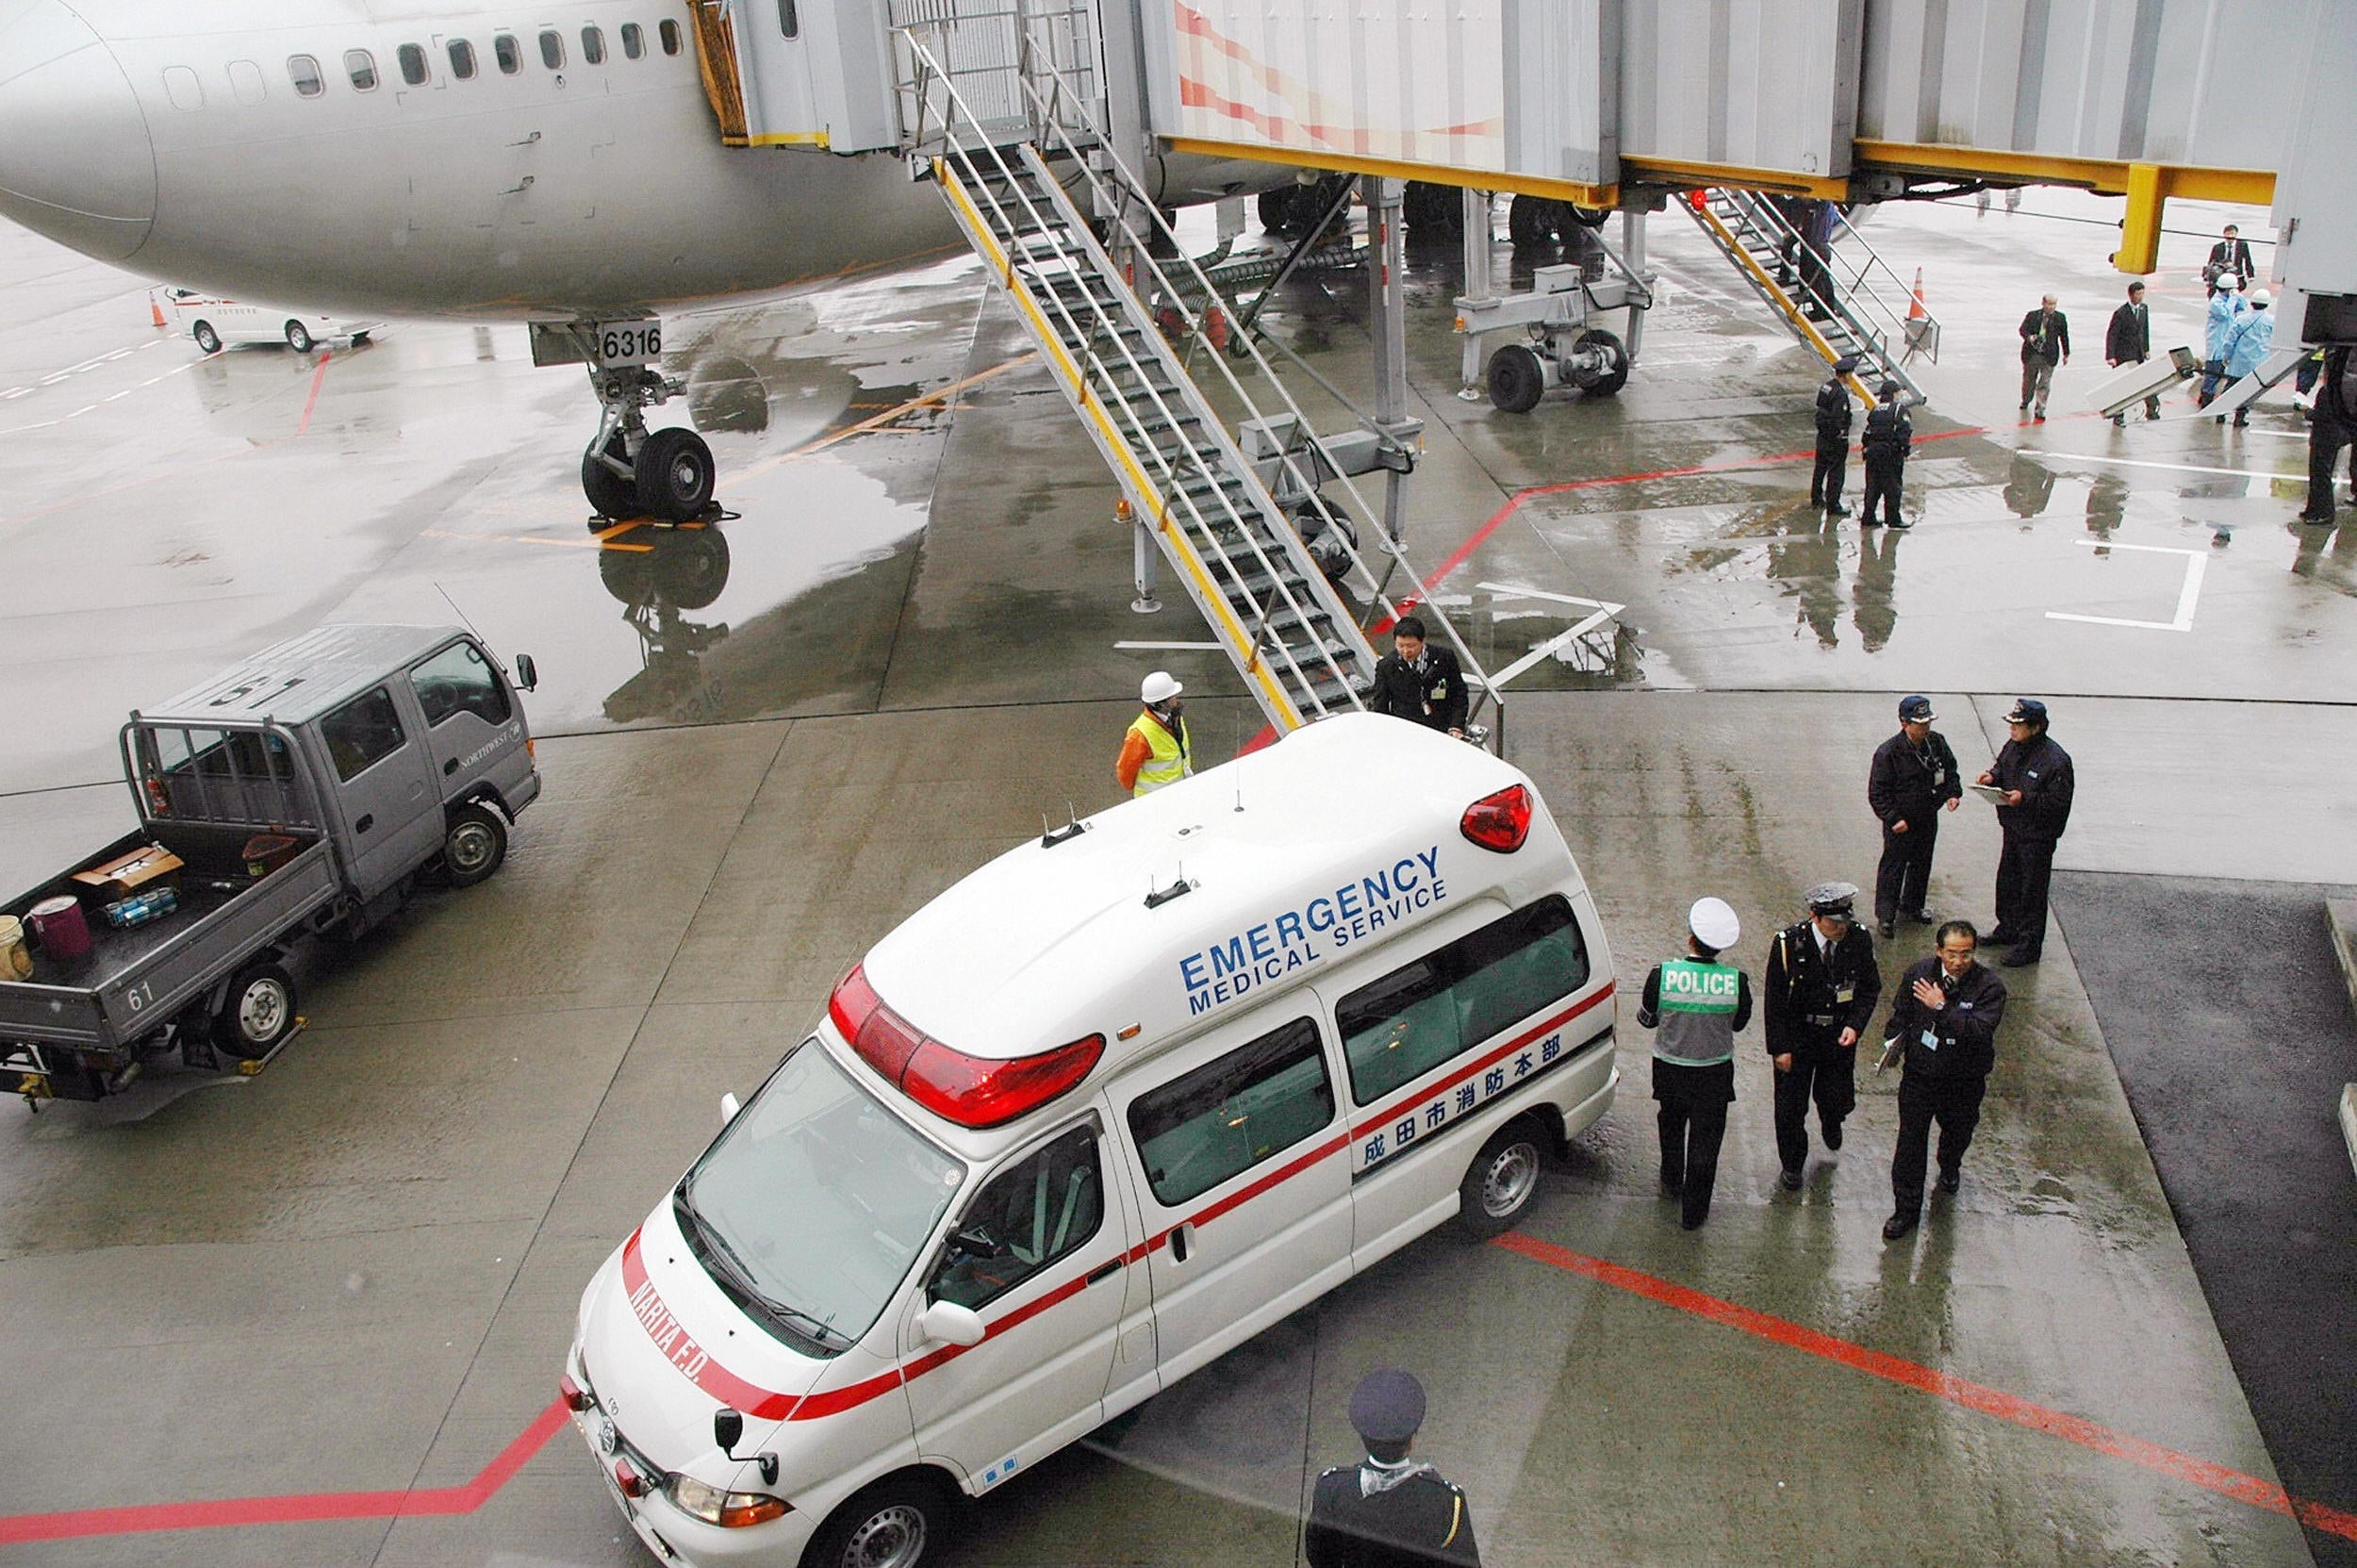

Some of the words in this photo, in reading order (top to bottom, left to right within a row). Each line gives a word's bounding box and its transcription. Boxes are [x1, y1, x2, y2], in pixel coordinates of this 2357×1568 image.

[603, 328, 661, 359] 6316
[1179, 845, 1440, 992] EMERGENCY
[1189, 943, 1321, 1016] MEDICAL
[1333, 879, 1447, 948] SERVICE
[128, 981, 153, 1012] 61
[1665, 969, 1736, 996] POLICE
[1363, 1033, 1561, 1165] 成田市消防本部
[630, 1279, 684, 1354] NARITA
